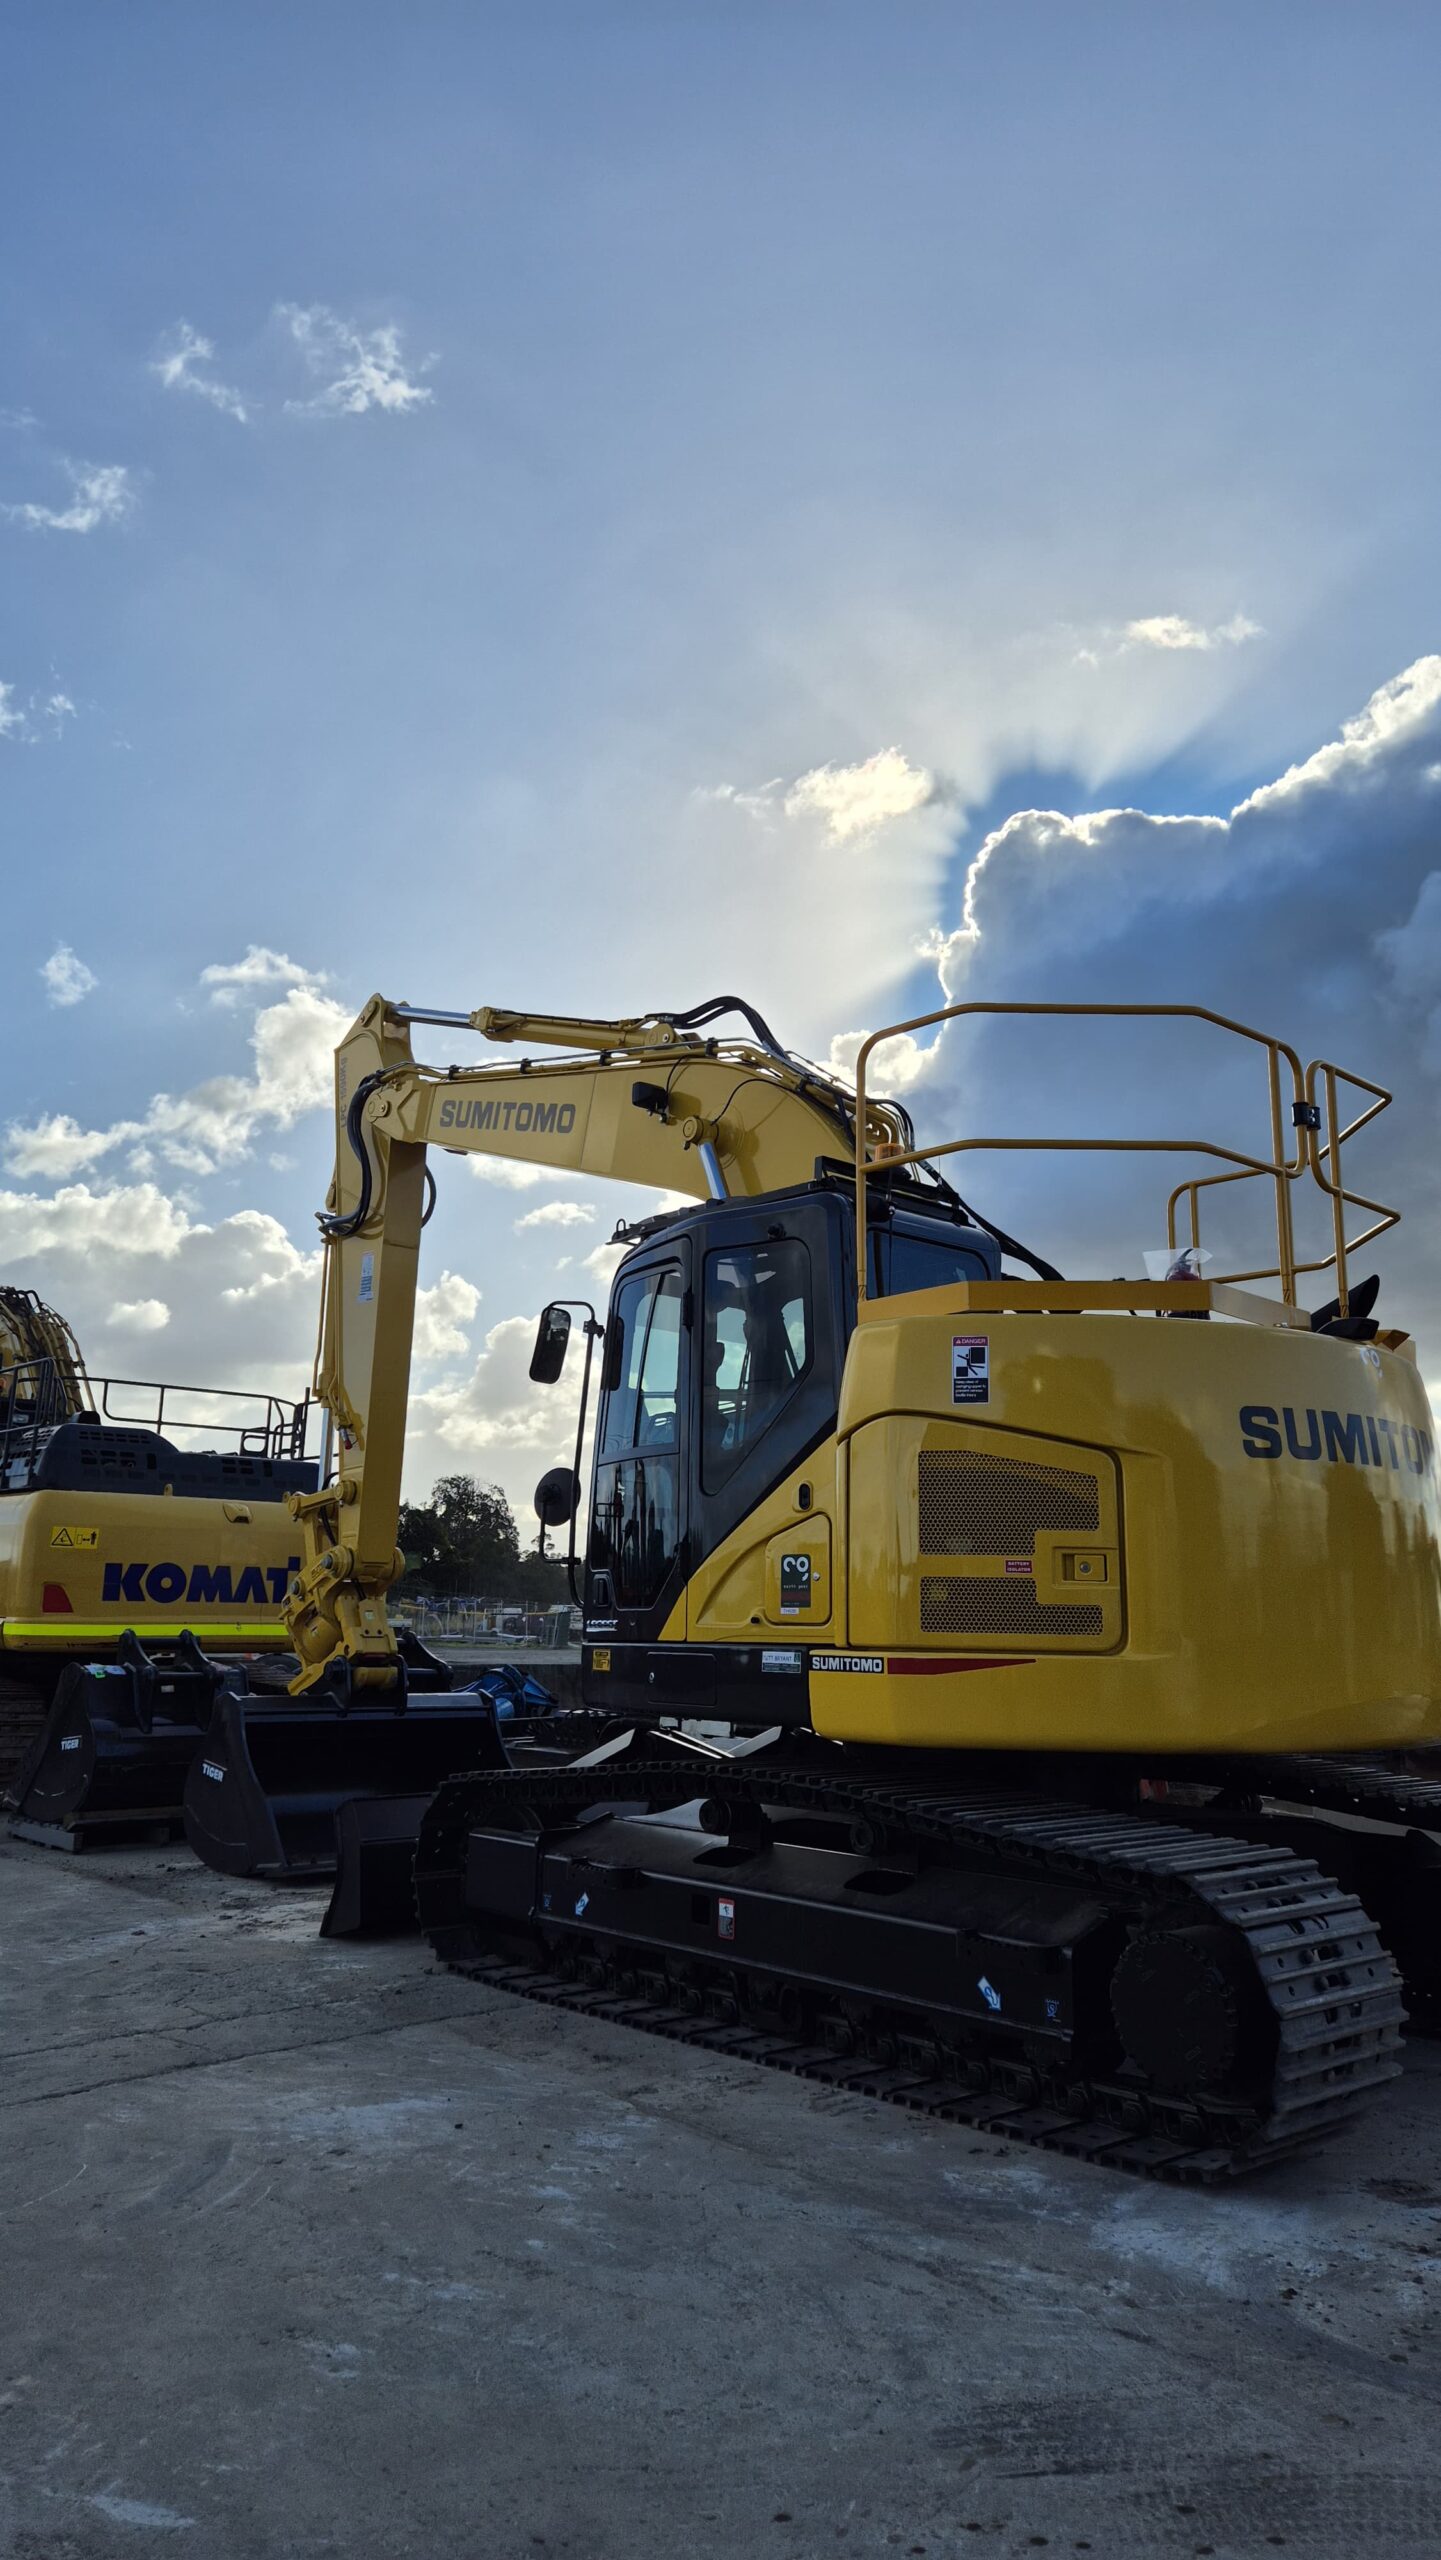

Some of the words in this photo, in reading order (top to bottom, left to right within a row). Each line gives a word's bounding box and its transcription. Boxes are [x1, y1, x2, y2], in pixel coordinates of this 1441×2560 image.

[440, 1100, 576, 1133] SUMITOMO
[102, 1556, 301, 1604] KOMAT
[812, 1656, 882, 1672] SUMITOMO
[61, 1738, 79, 1750] TIGER
[202, 1762, 225, 1783] TIGER
